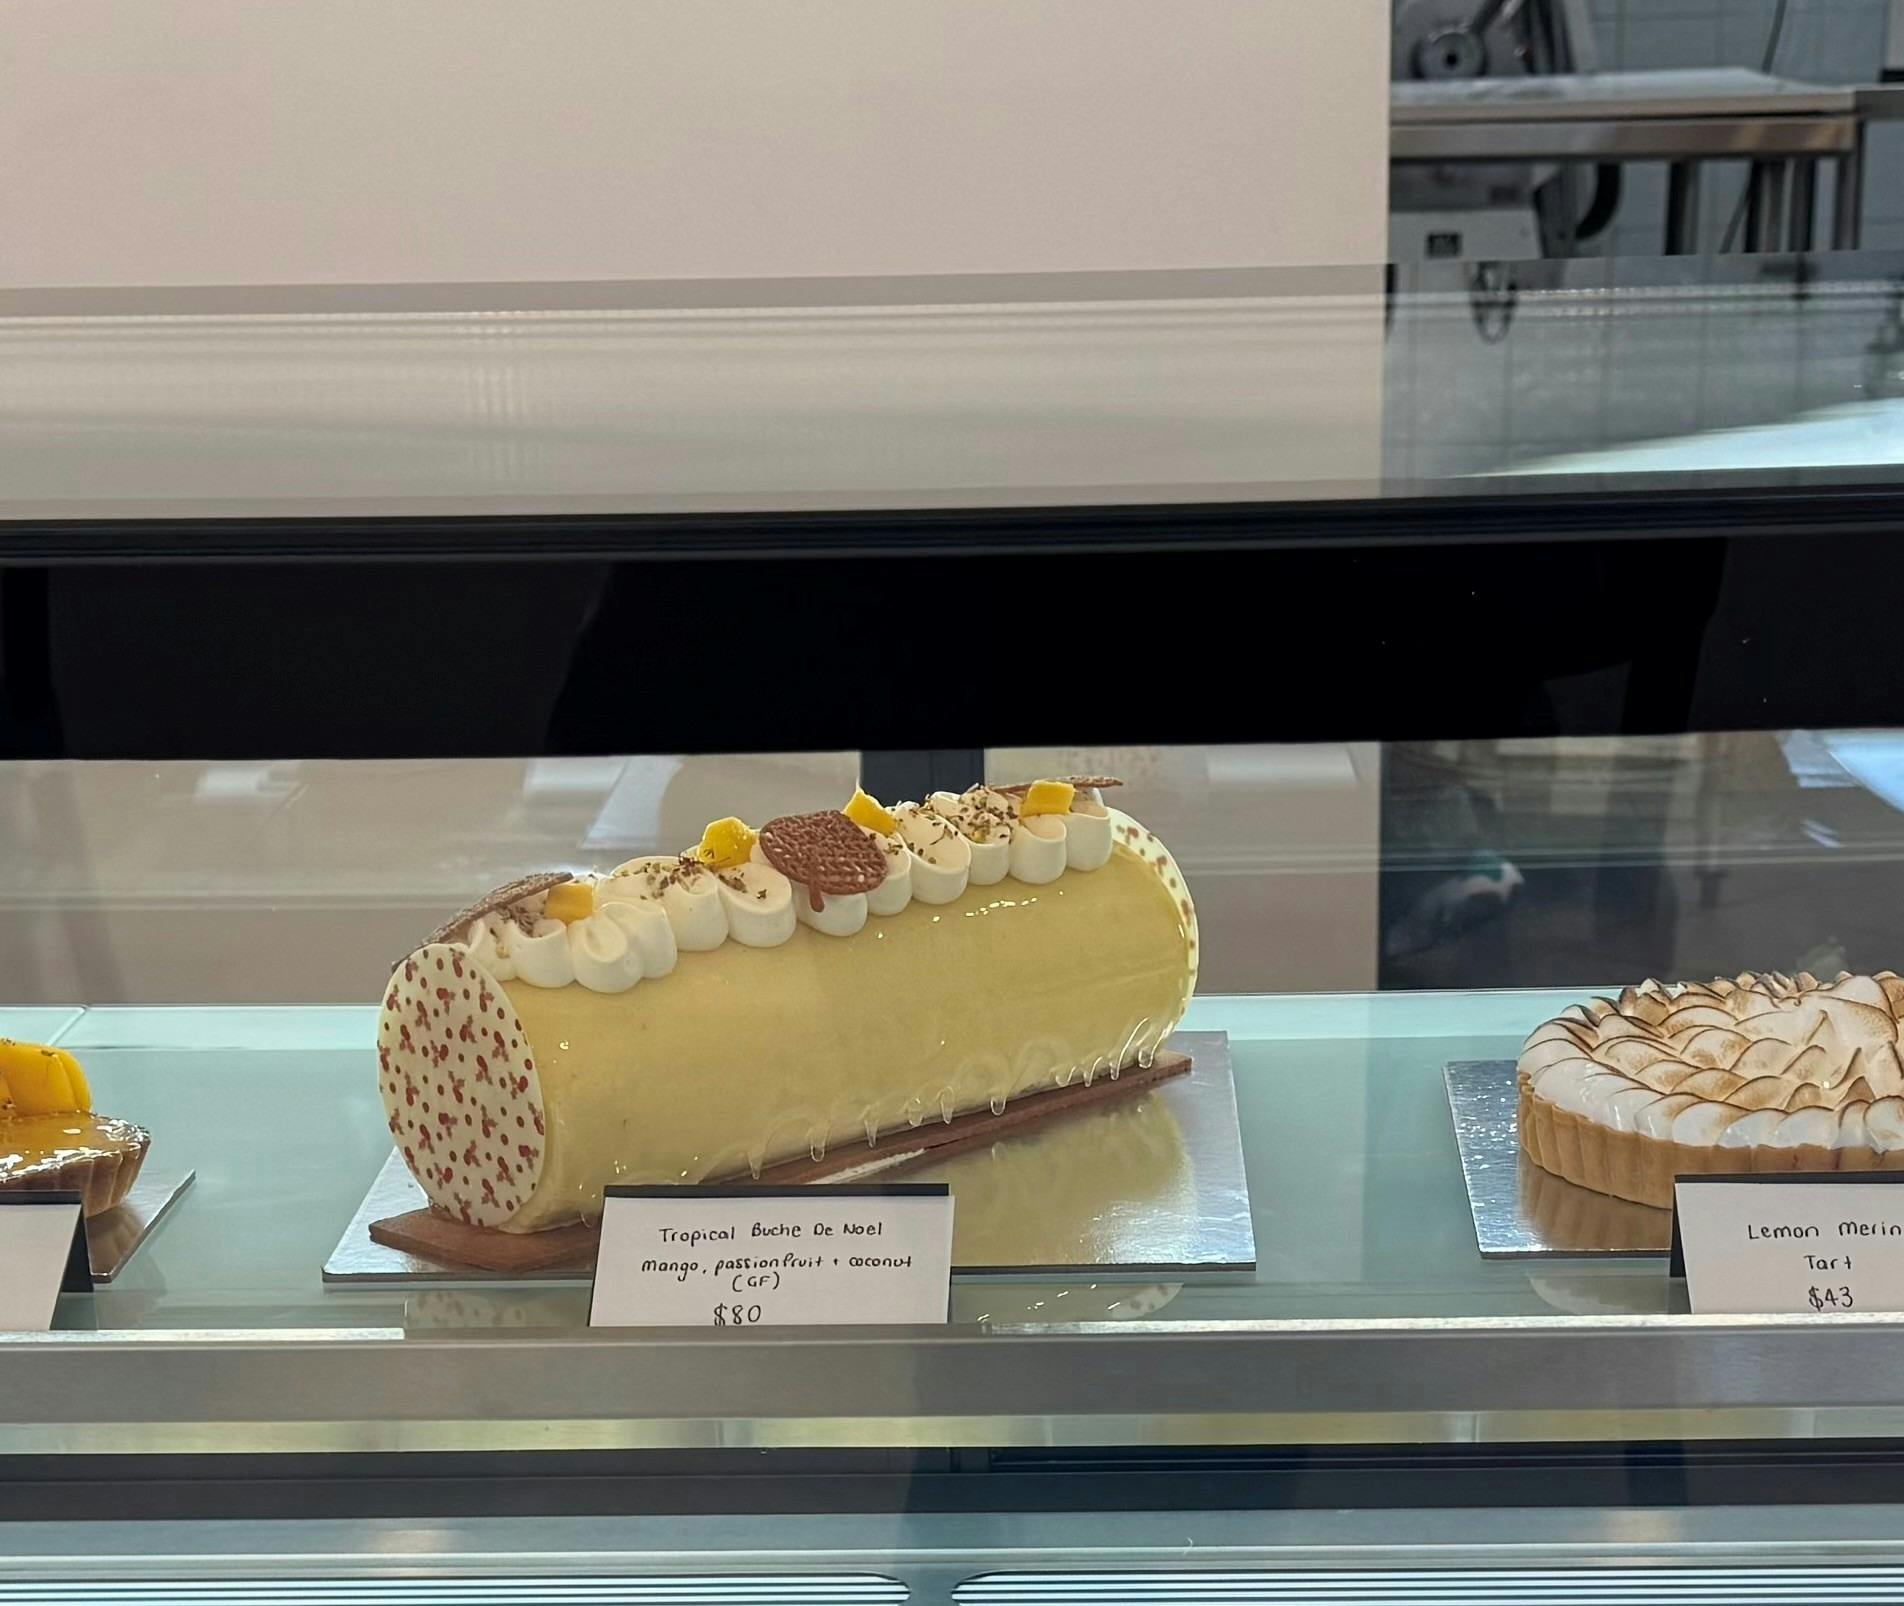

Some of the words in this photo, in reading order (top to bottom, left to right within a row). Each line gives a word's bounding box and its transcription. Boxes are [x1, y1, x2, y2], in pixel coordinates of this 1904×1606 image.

[658, 1226, 736, 1247] Tropical
[751, 1223, 801, 1239] Buche
[813, 1223, 834, 1236] De
[843, 1221, 883, 1236] Noel
[1748, 1224, 1819, 1240] Lemon
[849, 1255, 912, 1269] coconut
[1804, 1254, 1853, 1271] Tart
[731, 1271, 781, 1292] (GF)
[1808, 1285, 1853, 1311] $43
[713, 1303, 762, 1326] $80
